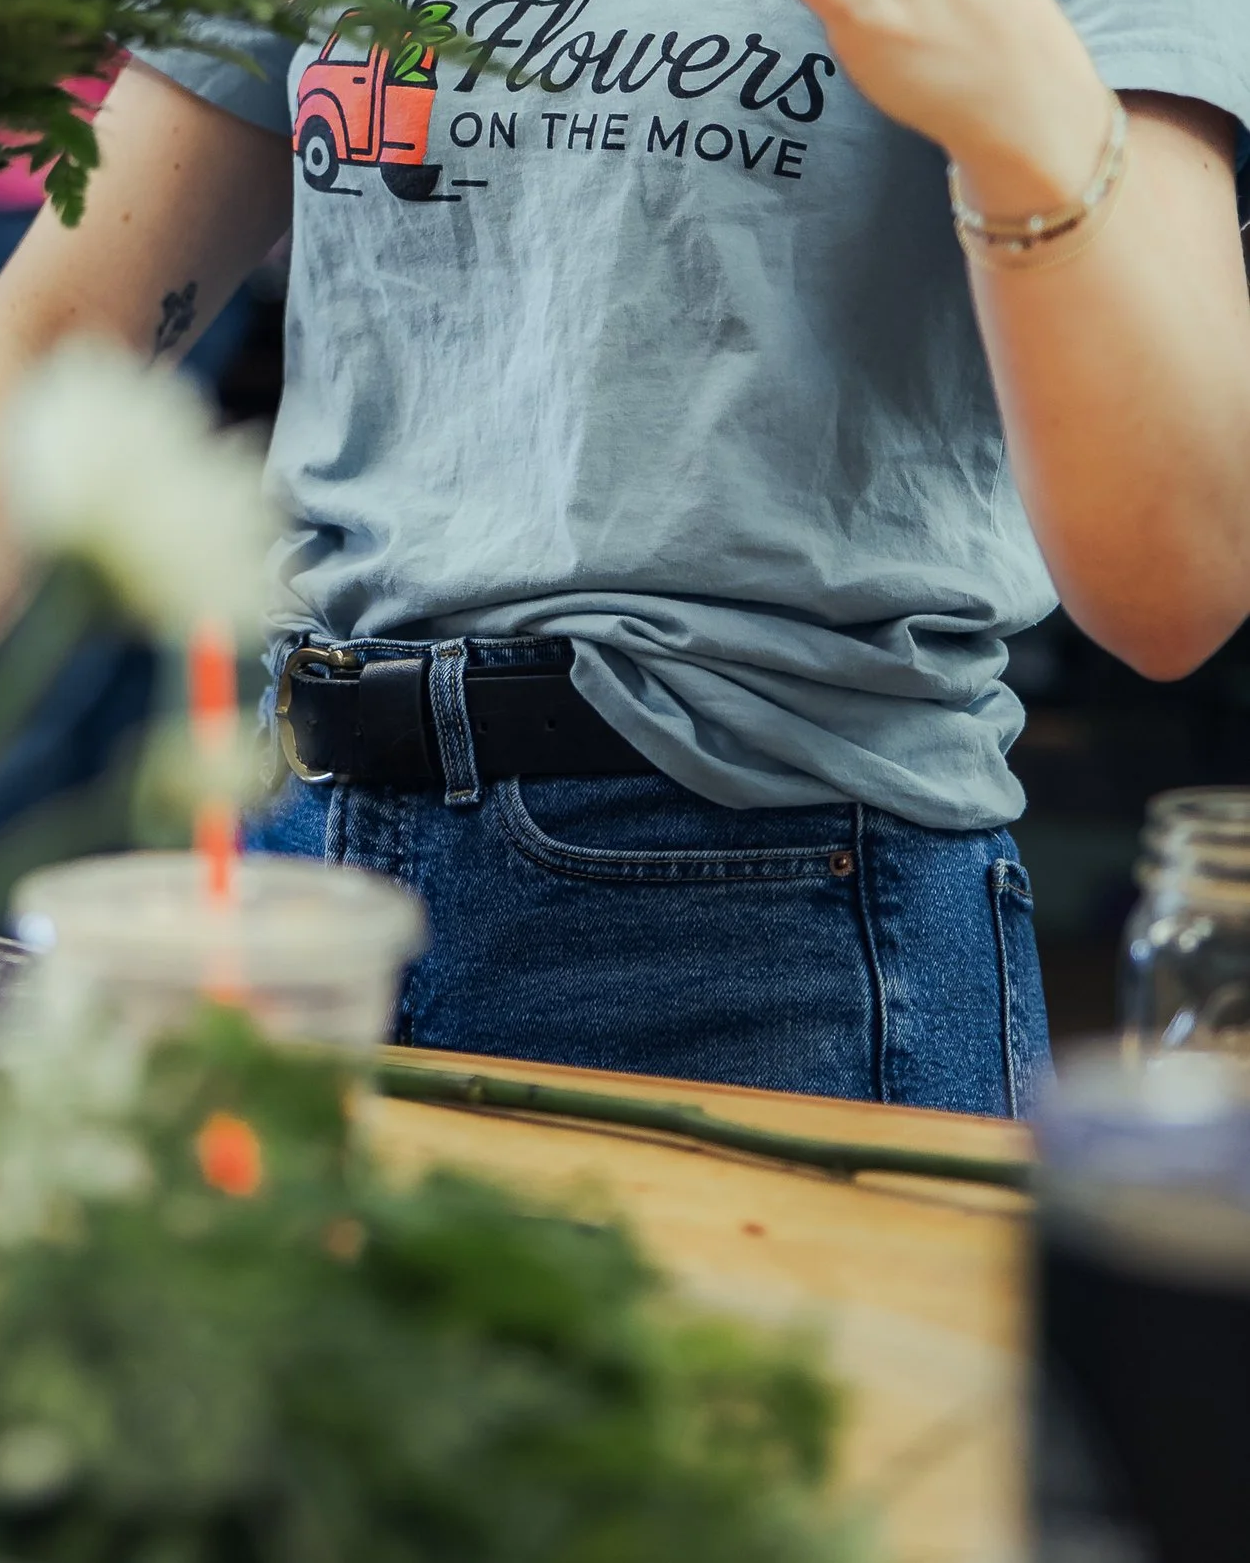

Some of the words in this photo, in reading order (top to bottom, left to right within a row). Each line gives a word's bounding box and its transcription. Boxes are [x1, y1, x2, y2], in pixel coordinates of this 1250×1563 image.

[450, 112, 518, 149] ON
[541, 112, 629, 151] THE
[648, 115, 808, 179] MOVE
